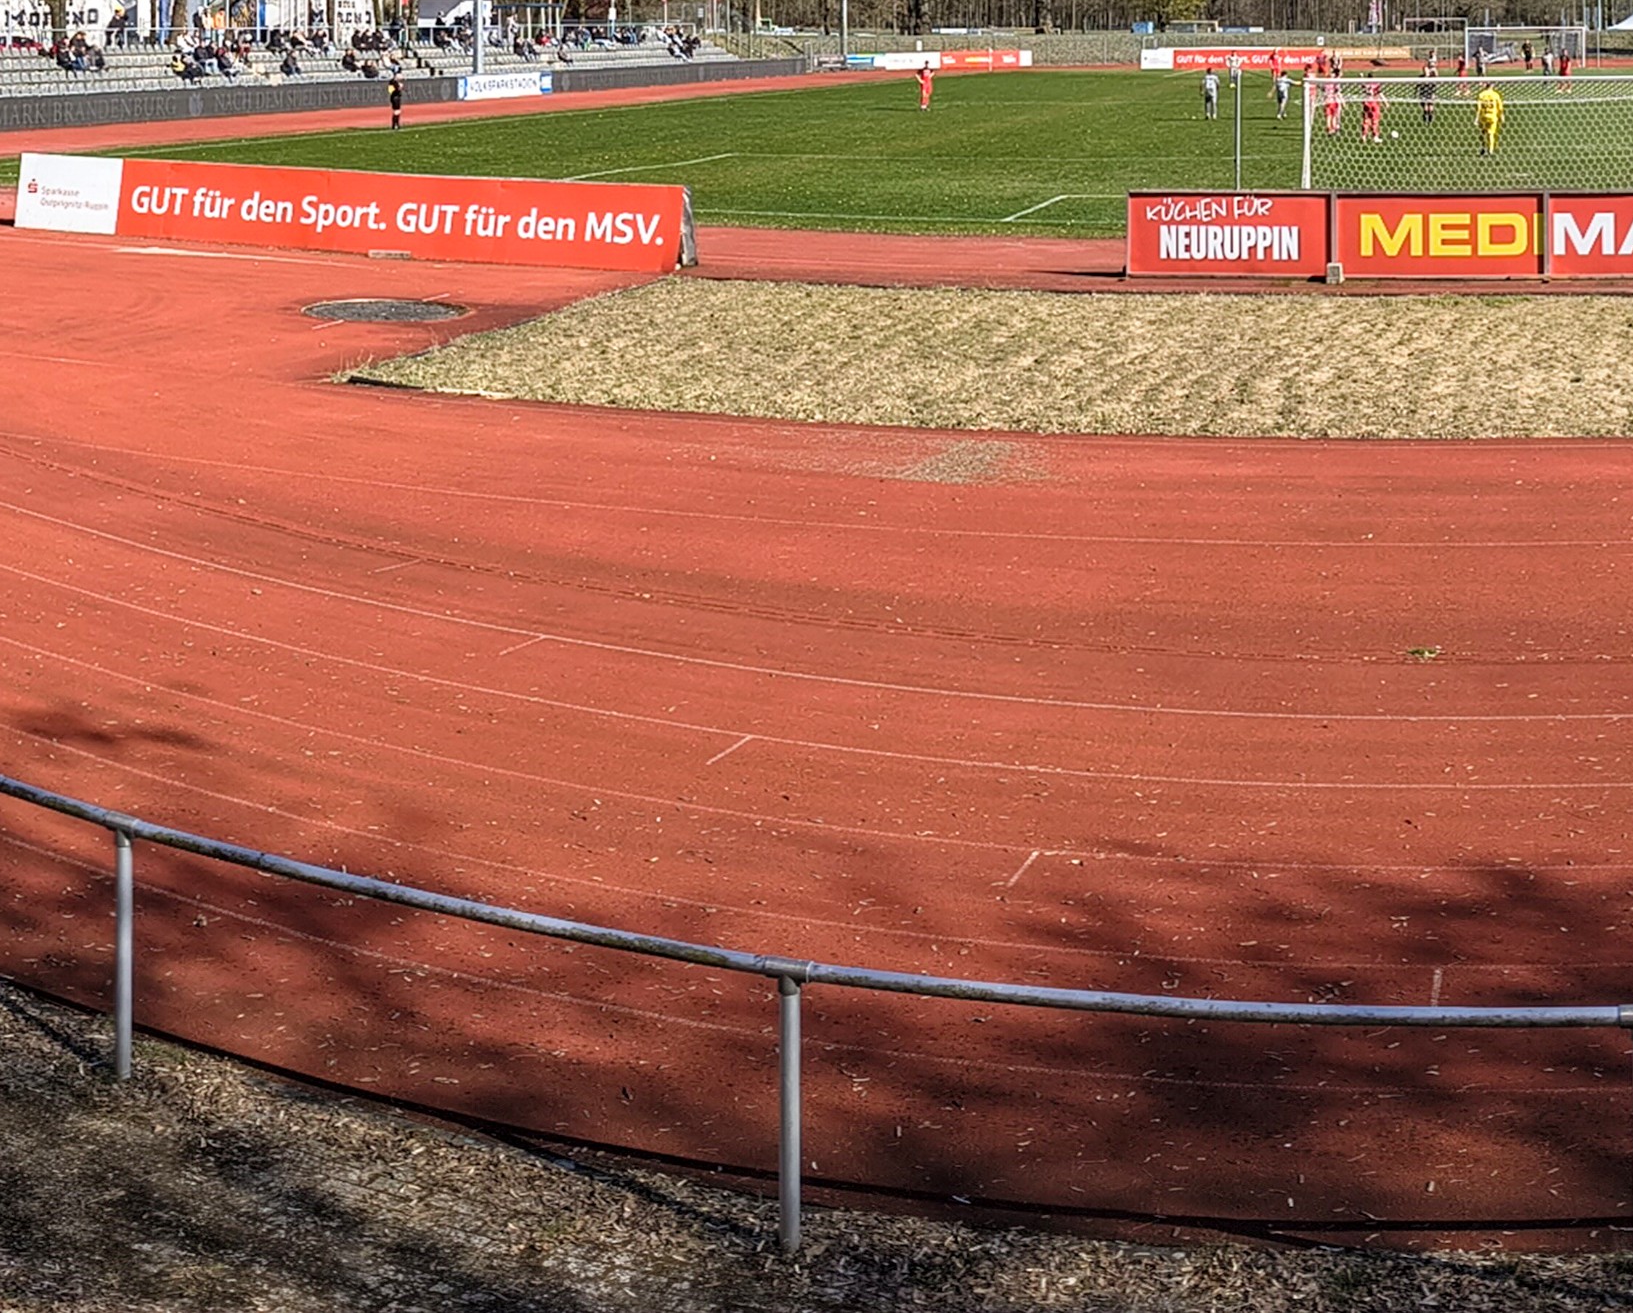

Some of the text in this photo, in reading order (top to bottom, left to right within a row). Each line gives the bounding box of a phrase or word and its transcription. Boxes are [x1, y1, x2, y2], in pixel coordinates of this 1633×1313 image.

[52, 95, 177, 123] BRANDENBURG
[131, 186, 664, 246] GUT für den Sport. GUT für den MSV.
[1146, 196, 1273, 222] KÜCHEN FÜR
[1159, 225, 1299, 261] NEURUPPIN
